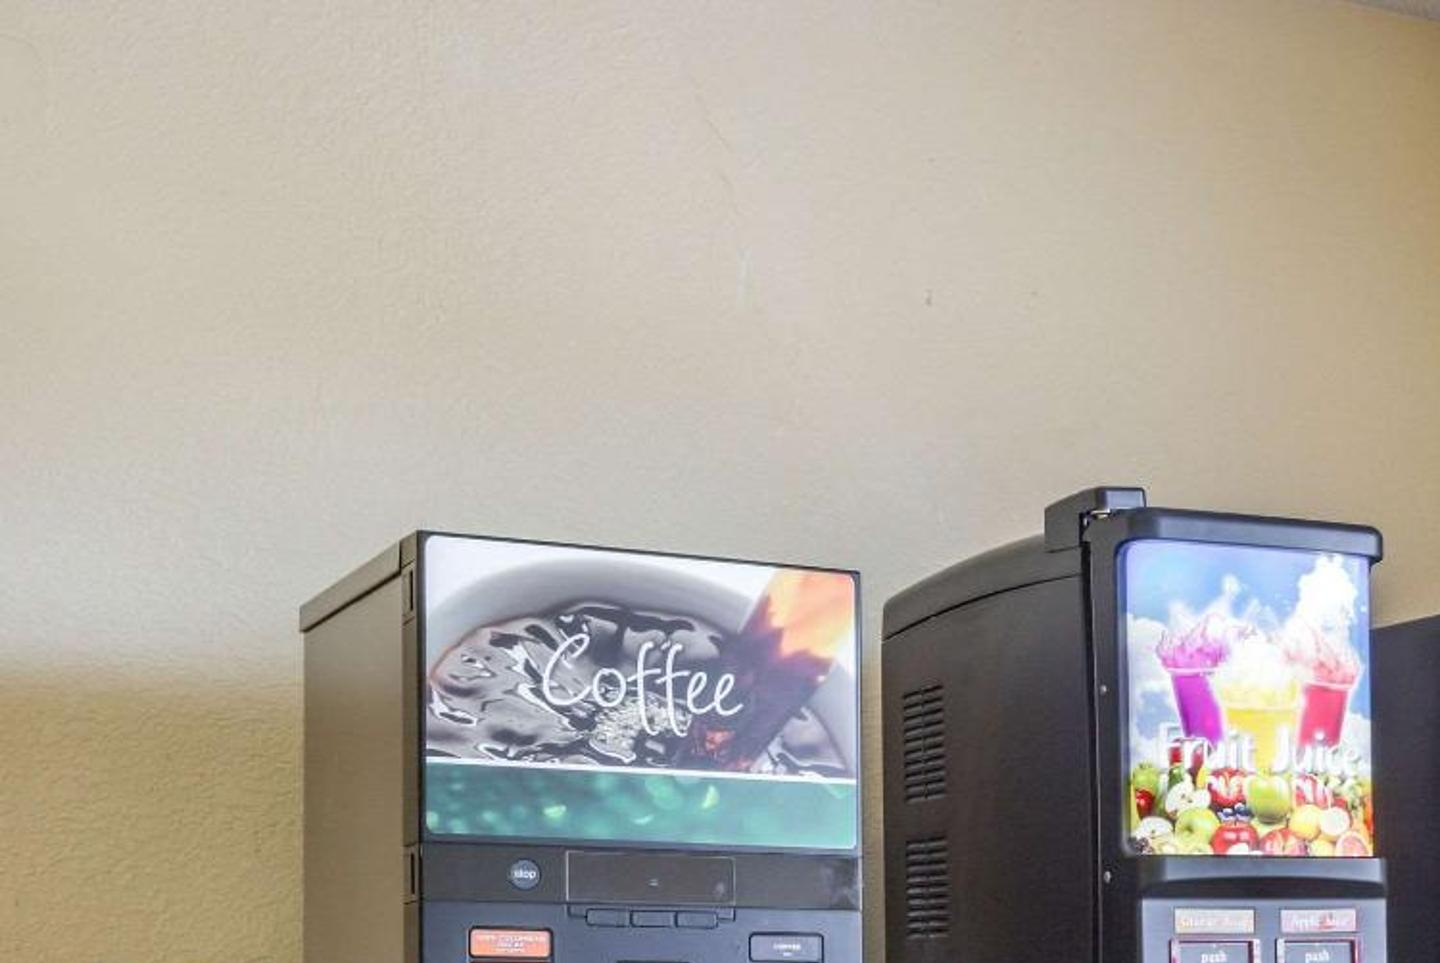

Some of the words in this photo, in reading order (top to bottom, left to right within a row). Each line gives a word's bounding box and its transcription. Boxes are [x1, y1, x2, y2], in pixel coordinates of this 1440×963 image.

[541, 633, 743, 738] Coffee
[513, 869, 537, 880] stop
[1305, 950, 1330, 963] push
